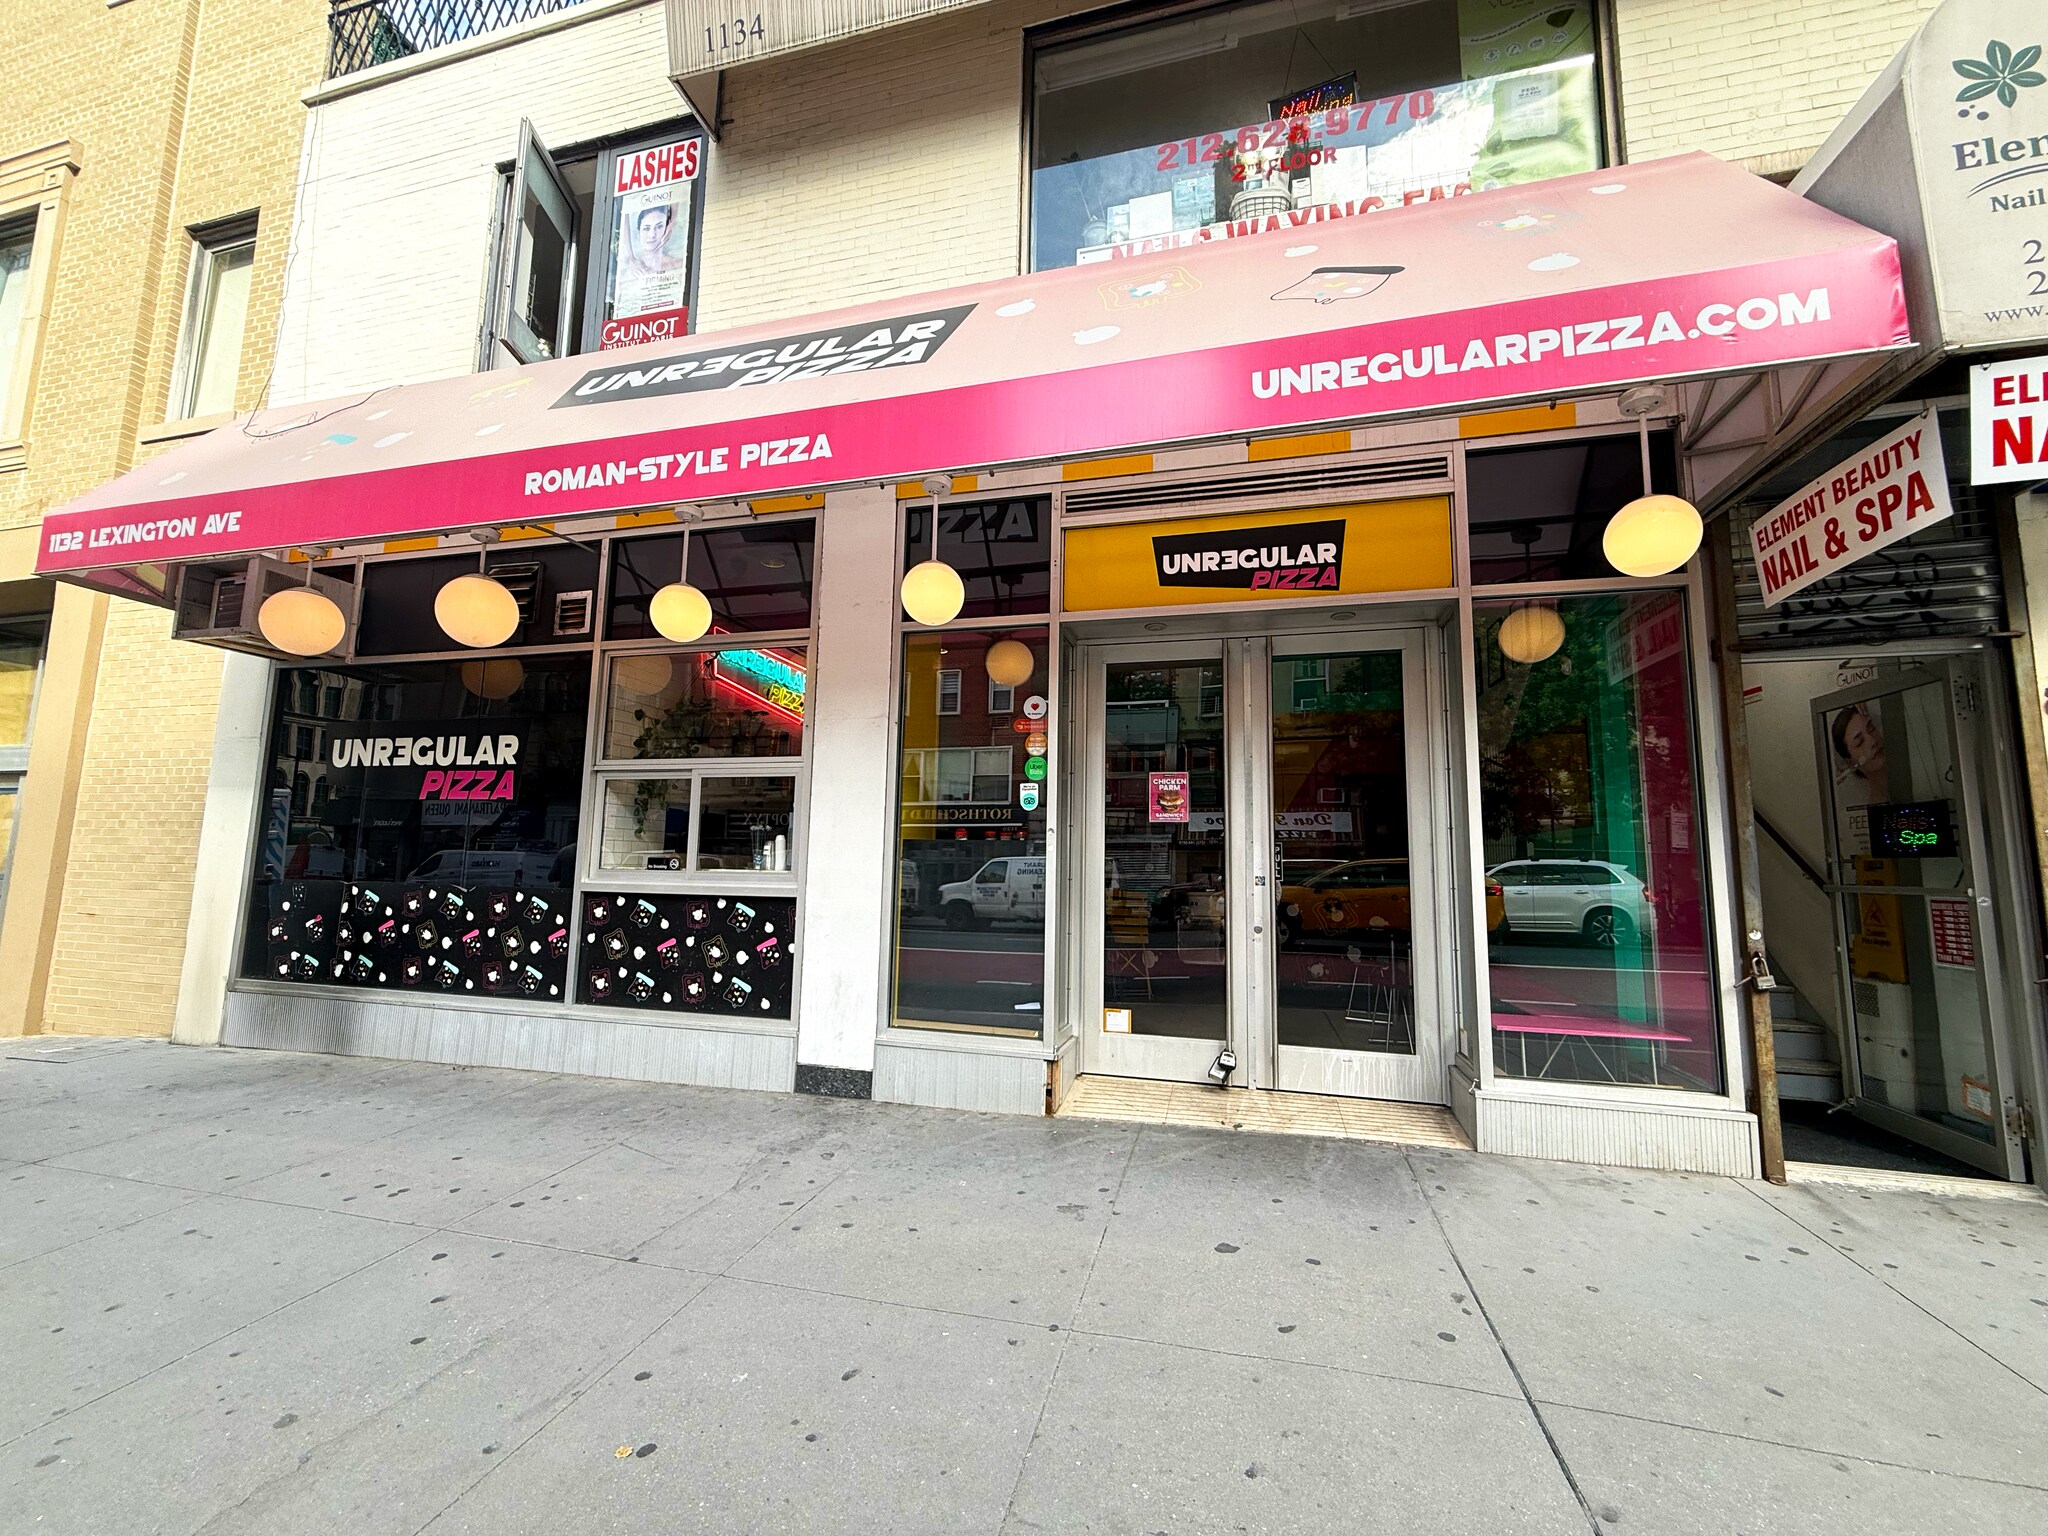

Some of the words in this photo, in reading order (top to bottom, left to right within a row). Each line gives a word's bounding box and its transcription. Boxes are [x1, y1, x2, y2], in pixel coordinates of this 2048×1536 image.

[704, 13, 765, 53] 1134
[617, 140, 698, 193] LASHES
[1266, 147, 1338, 180] FLOOR
[640, 190, 673, 205] GUINOT
[1989, 188, 2047, 213] Nail
[601, 316, 679, 344] GUINOT
[1251, 287, 1831, 399] UNREGULARPIZZA.COM
[722, 341, 929, 391] PIZZA
[524, 447, 729, 495] ROMAN-STYLE
[740, 433, 833, 469] PIZZA
[1756, 487, 1826, 553] ELEMENT
[1831, 429, 1922, 505] BEAUTY
[48, 530, 84, 553] 1132
[88, 516, 197, 548] LEXINGTON
[202, 511, 242, 535] AVE
[1762, 534, 1819, 595] NAIL
[1824, 517, 1849, 559] &
[1855, 470, 1935, 542] SPA
[1250, 566, 1337, 591] PIZZA
[1836, 667, 1875, 688] GUINOT
[419, 770, 514, 800] PIZZA
[1899, 830, 1938, 845] Spa
